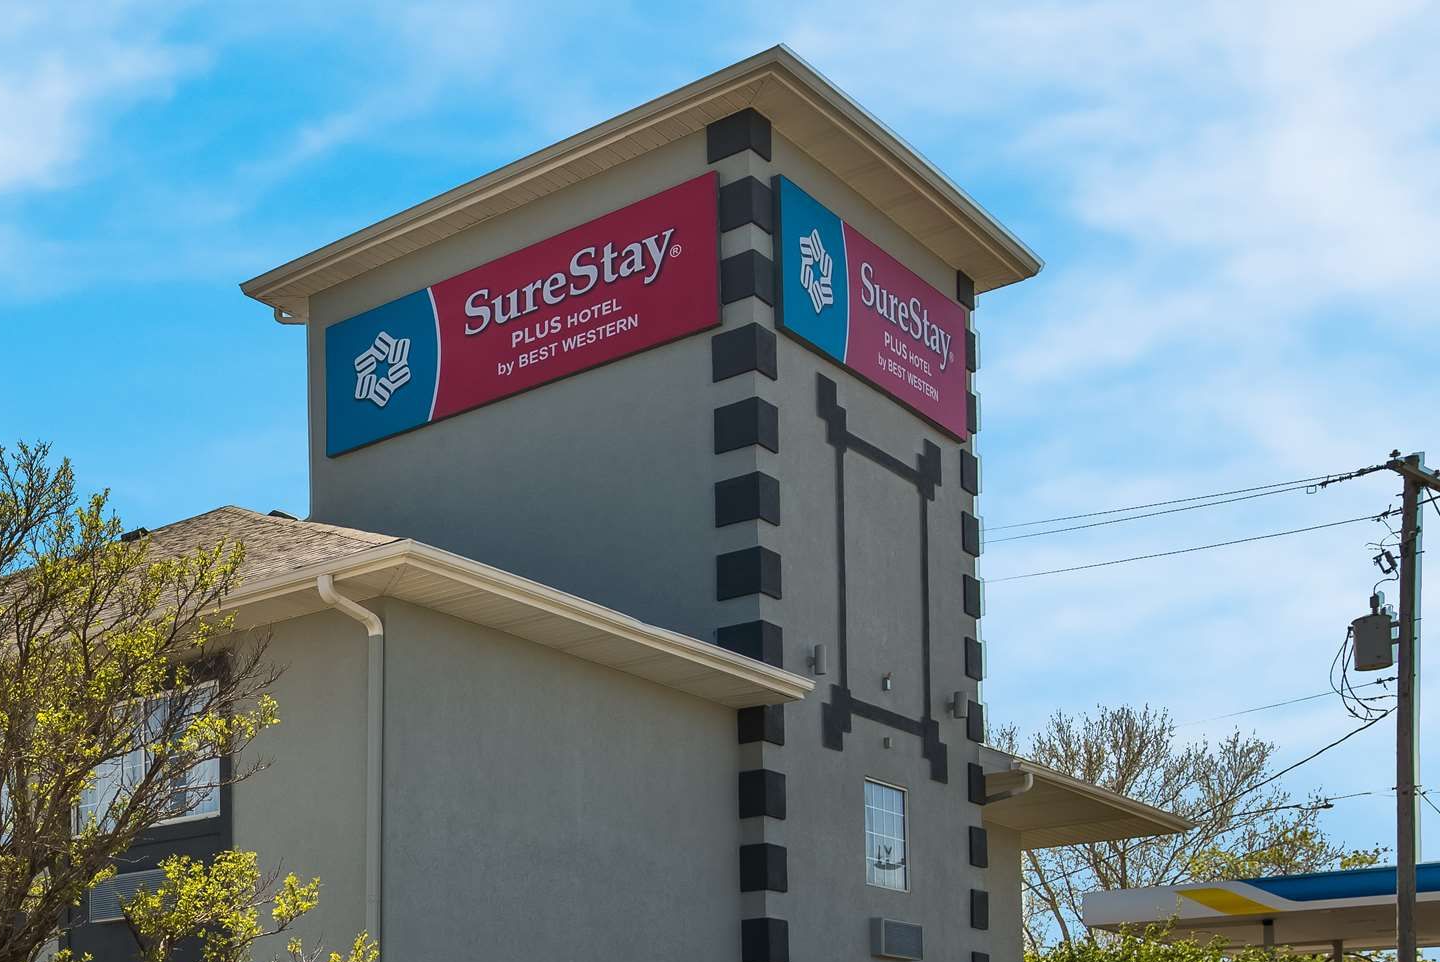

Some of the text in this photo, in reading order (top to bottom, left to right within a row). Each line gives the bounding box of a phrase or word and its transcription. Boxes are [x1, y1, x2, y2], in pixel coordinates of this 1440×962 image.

[497, 314, 640, 377] by BEST WESTERN
[511, 298, 622, 348] PLUS HOTEL
[878, 352, 939, 403] by BEST WESTERN
[884, 331, 932, 377] PLUS HOTEL
